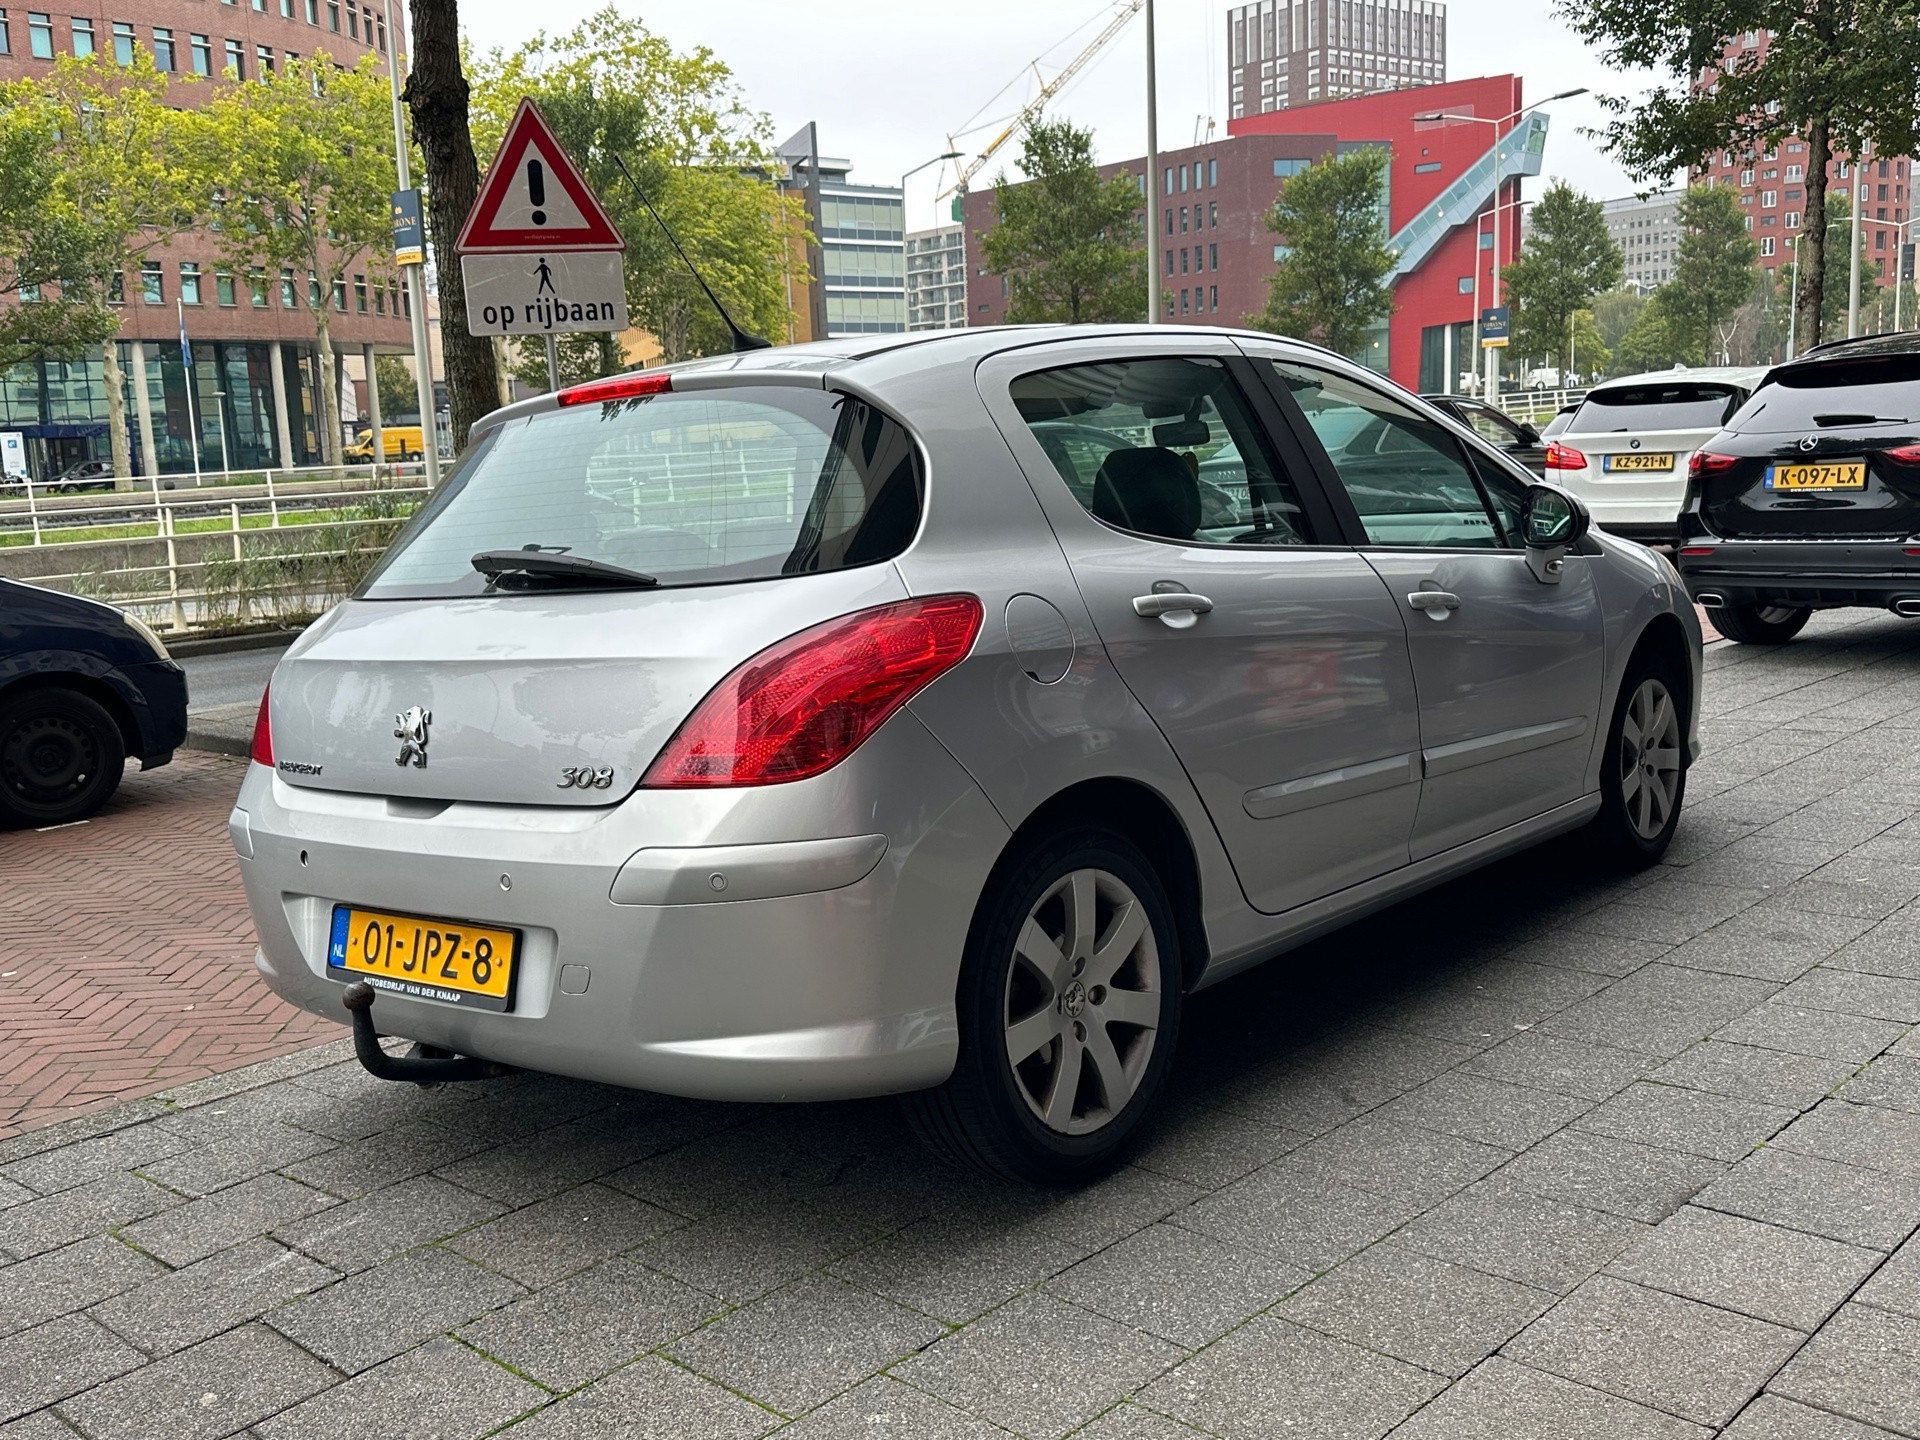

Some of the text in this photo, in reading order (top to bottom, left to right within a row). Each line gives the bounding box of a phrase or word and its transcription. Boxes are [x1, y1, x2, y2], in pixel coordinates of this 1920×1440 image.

[483, 297, 615, 330] op rijbaan
[1615, 456, 1667, 468] KZ-921-N
[1780, 466, 1858, 485] K-097-LX
[279, 760, 323, 775] PEUGEOT
[556, 764, 614, 789] 308
[332, 920, 493, 985] NL 01-JPZ-8
[363, 976, 461, 1002] AUTOBEDRIJF VAN DER KNAAP
